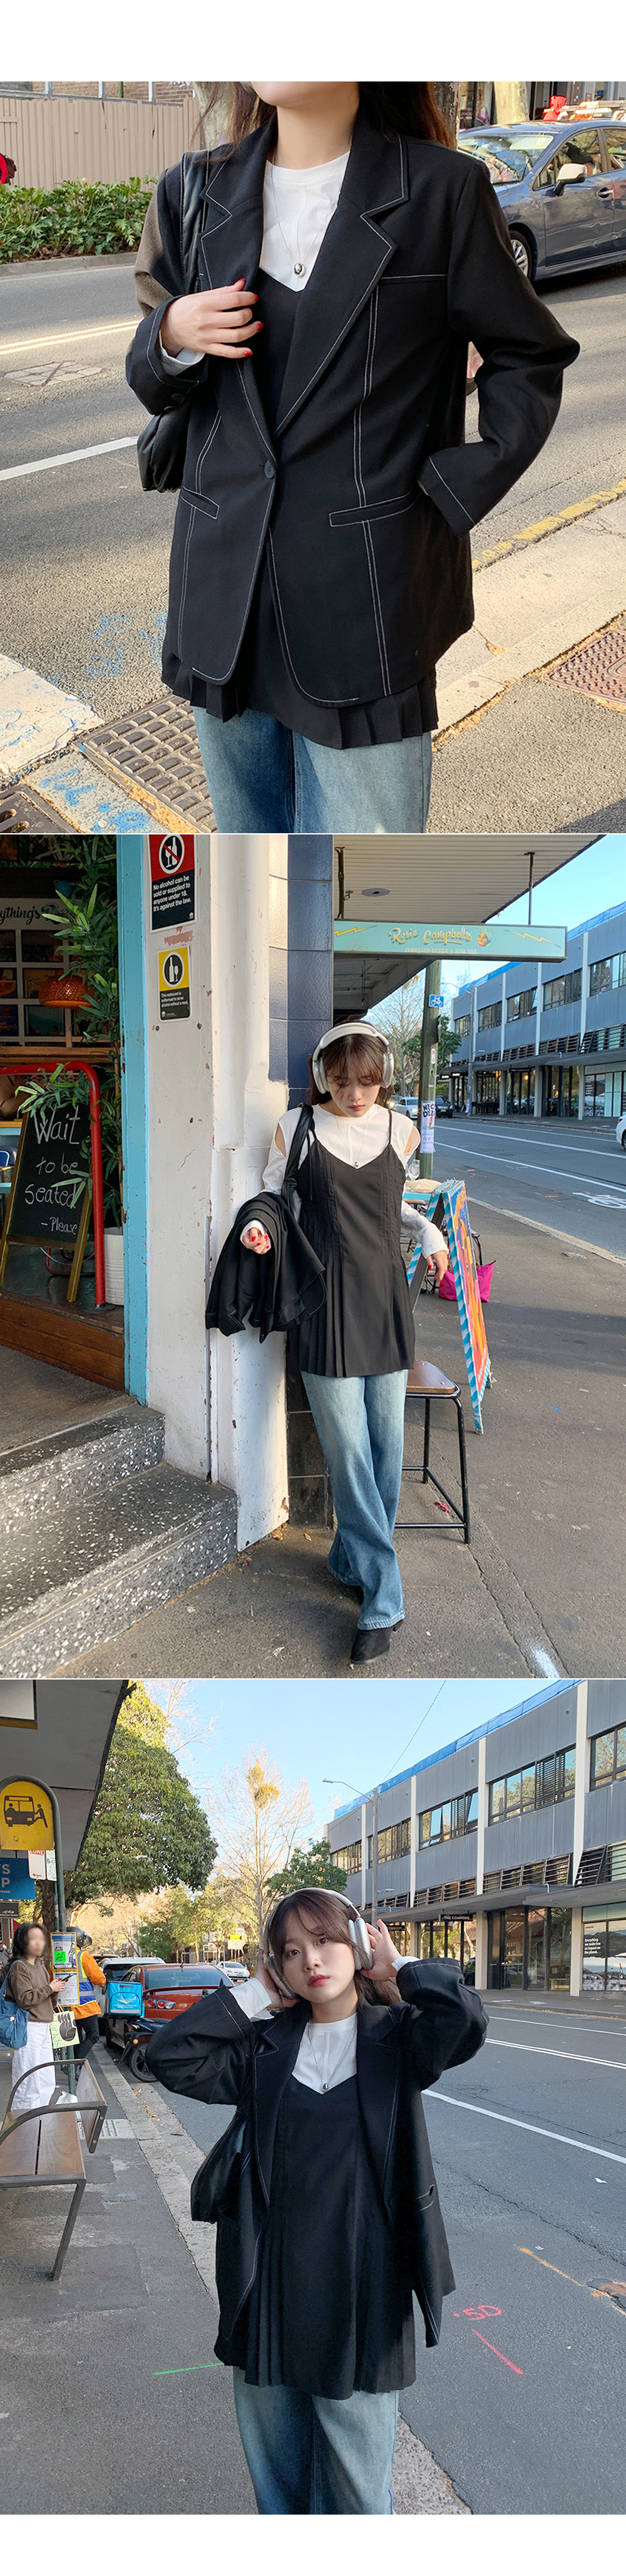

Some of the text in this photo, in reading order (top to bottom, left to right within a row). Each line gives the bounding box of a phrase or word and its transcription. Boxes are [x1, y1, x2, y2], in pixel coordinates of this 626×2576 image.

[160, 879, 174, 888] alcohol
[167, 883, 185, 893] supplied
[153, 896, 168, 905] anyone
[160, 901, 175, 911] against
[389, 927, 419, 944] Rosie
[34, 1104, 81, 1145] Wait
[36, 1153, 78, 1175] to be
[0, 1864, 11, 1875] S
